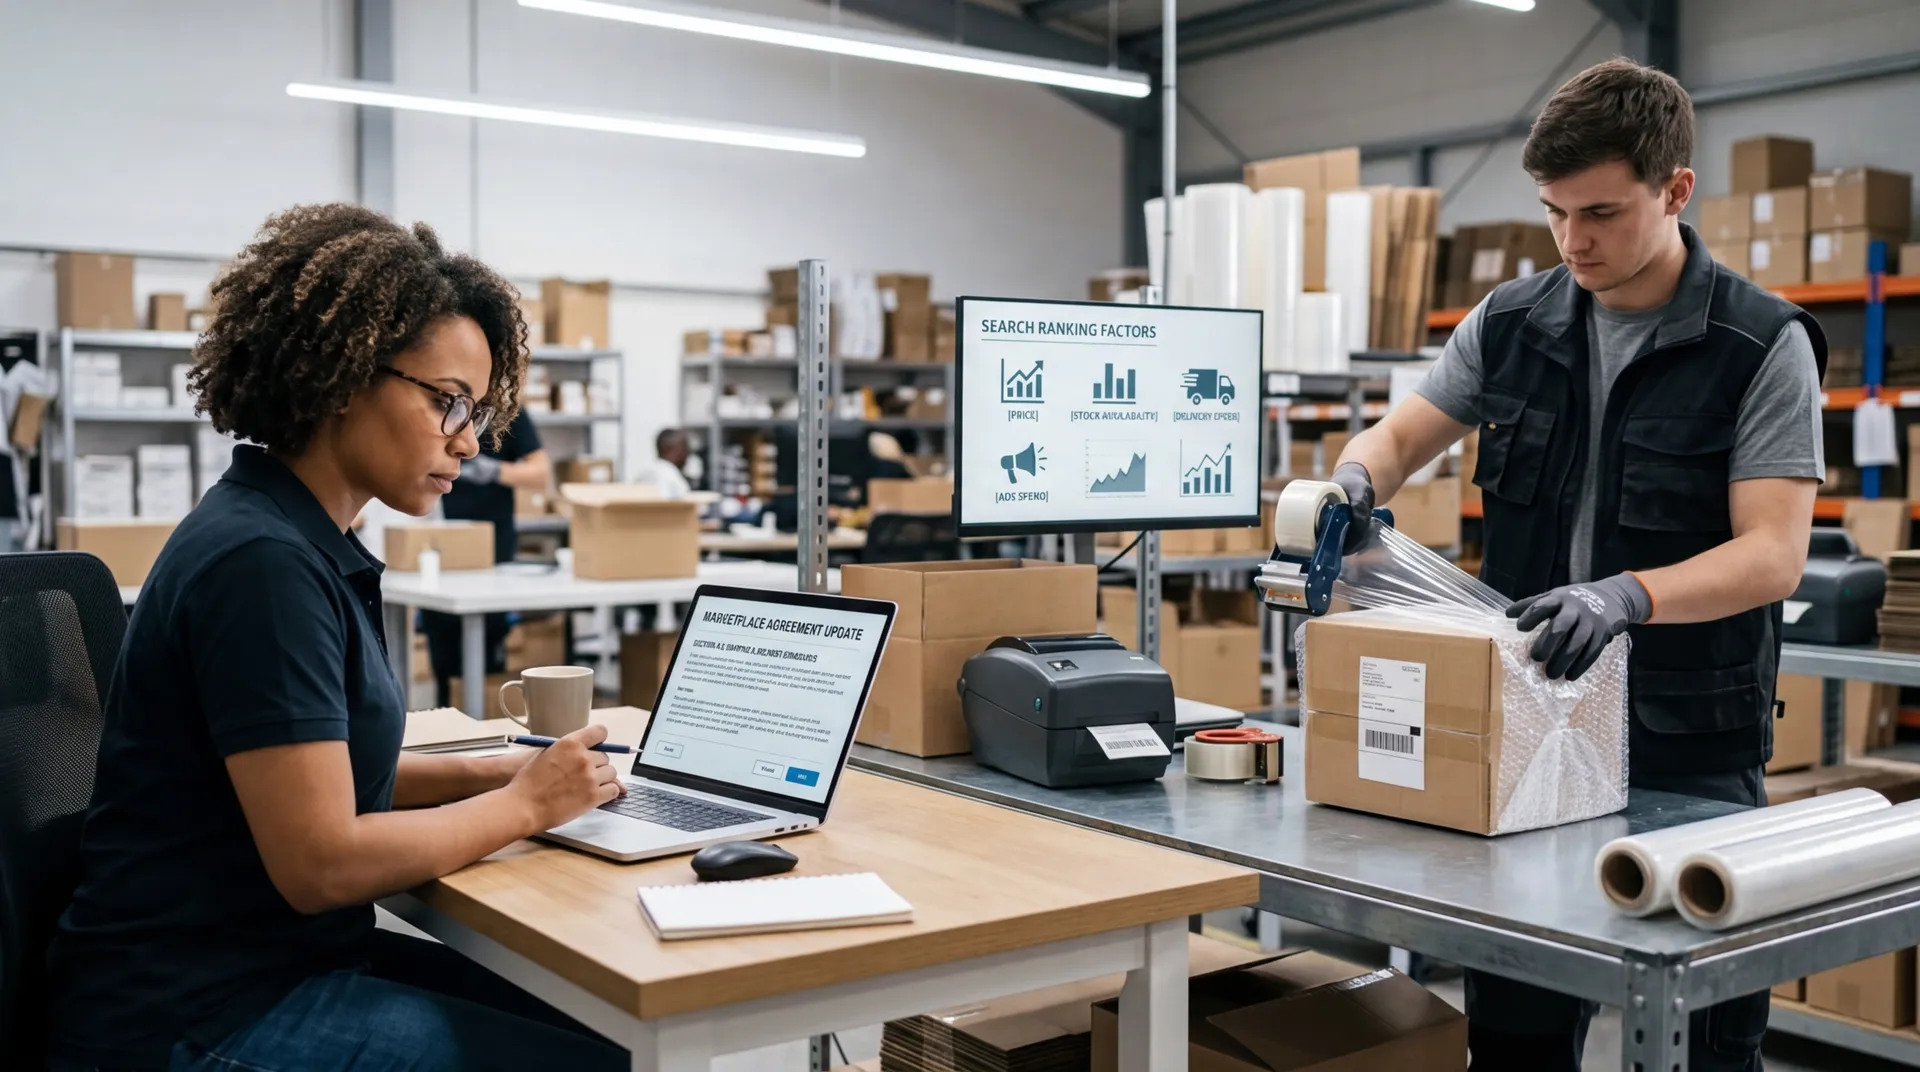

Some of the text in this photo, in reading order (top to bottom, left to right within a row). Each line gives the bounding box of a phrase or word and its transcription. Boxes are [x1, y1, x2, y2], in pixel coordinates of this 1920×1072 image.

[981, 319, 1157, 339] SEARCH RANKING FACTORS
[766, 618, 823, 637] AGREEMENT
